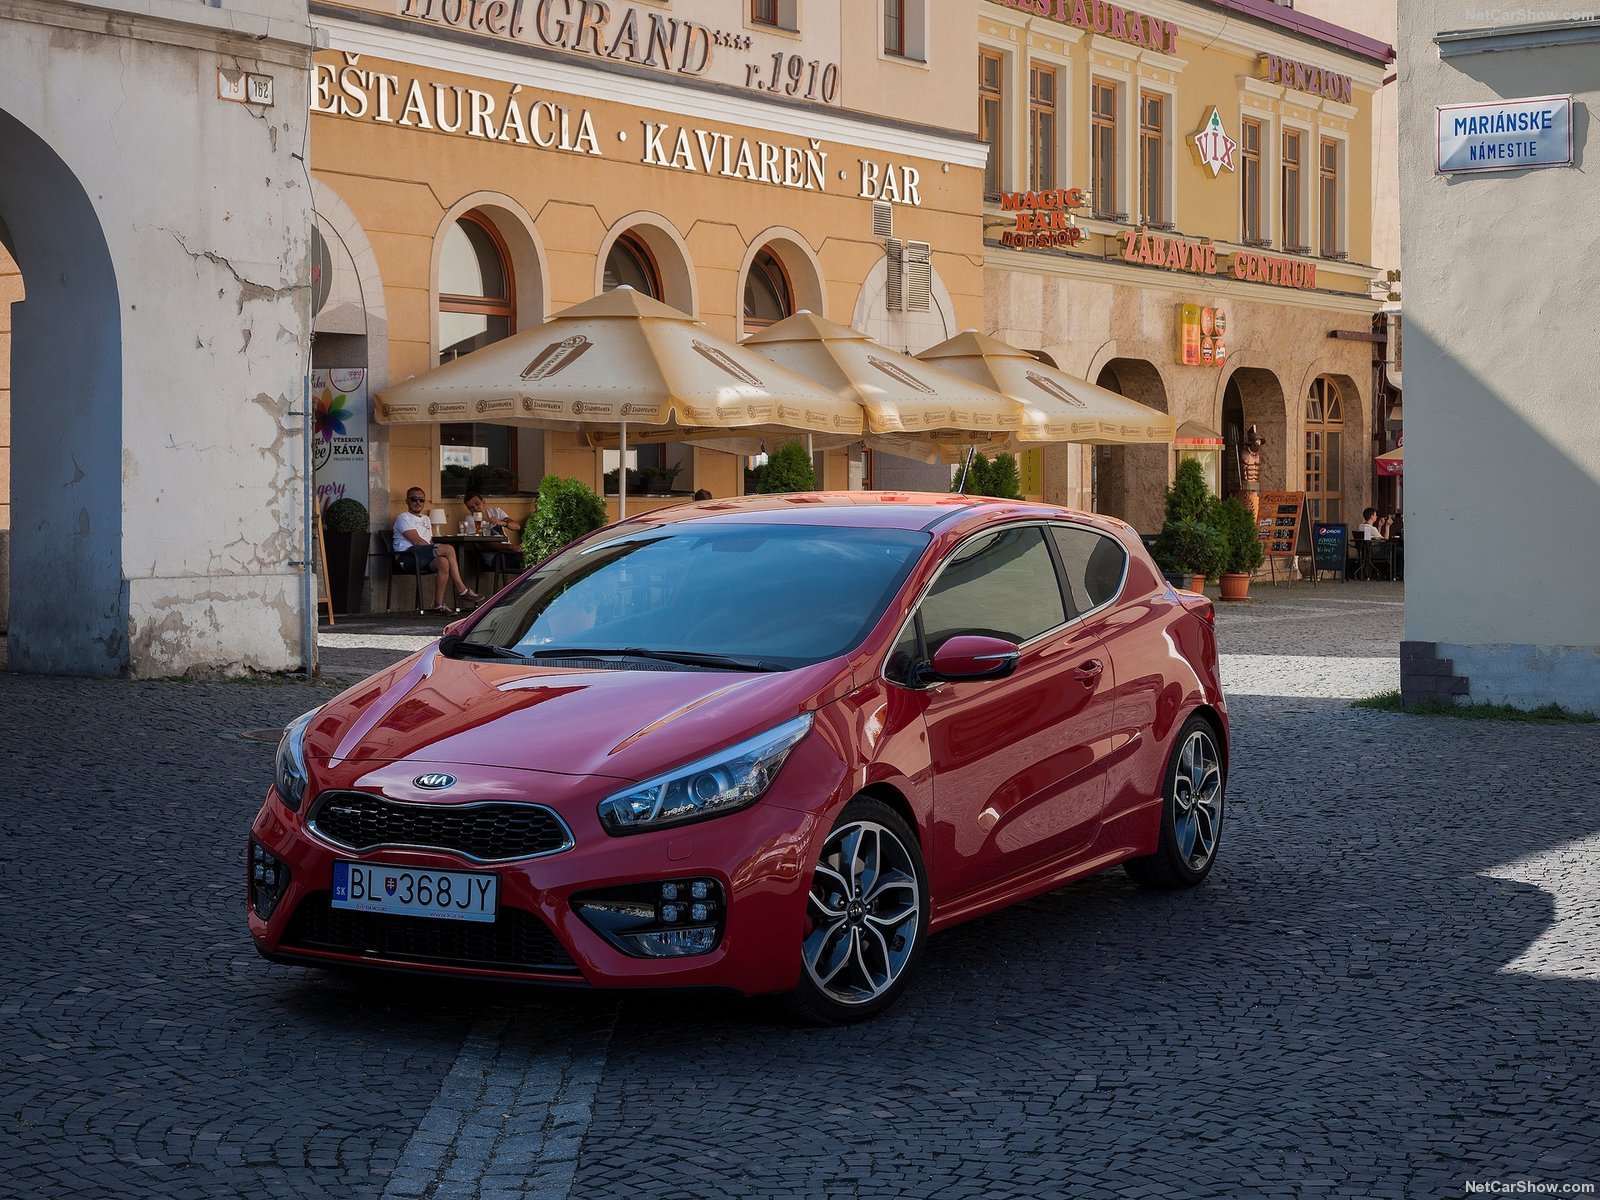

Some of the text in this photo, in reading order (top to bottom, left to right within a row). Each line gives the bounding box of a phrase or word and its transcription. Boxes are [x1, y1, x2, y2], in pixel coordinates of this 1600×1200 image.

[537, 0, 713, 75] GRAND
[1000, 0, 1178, 53] STAURANT
[254, 81, 269, 98] 162
[1267, 53, 1352, 103] PENZION
[1454, 110, 1552, 136] MARIÁNSKE
[641, 120, 827, 191] KAVIAREŇ
[858, 159, 921, 206] BAR
[1197, 132, 1235, 169] VIX
[1470, 141, 1537, 161] NÁMESTIE
[1001, 188, 1081, 211] MAGIC
[1016, 210, 1067, 232] BAR
[1000, 228, 1080, 248] nonstop
[1124, 227, 1317, 289] ZÁBAVNÉ CENTRUM
[333, 443, 364, 454] KÁVA
[419, 773, 447, 786] KIA
[336, 868, 491, 911] SK BL 368JY
